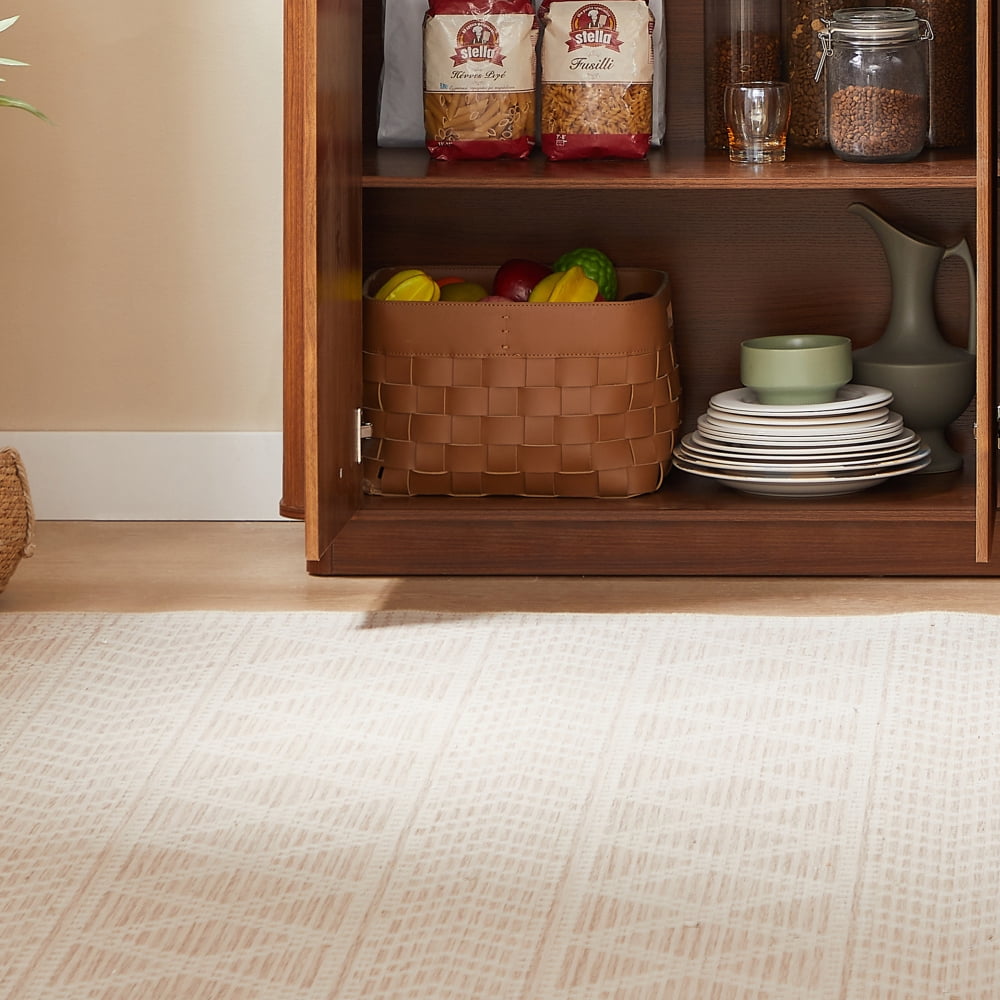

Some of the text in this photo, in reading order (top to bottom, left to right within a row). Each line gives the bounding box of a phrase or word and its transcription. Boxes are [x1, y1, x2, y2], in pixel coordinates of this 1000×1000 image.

[575, 30, 612, 44] stella
[460, 45, 496, 59] stella
[569, 57, 614, 71] Fusilli
